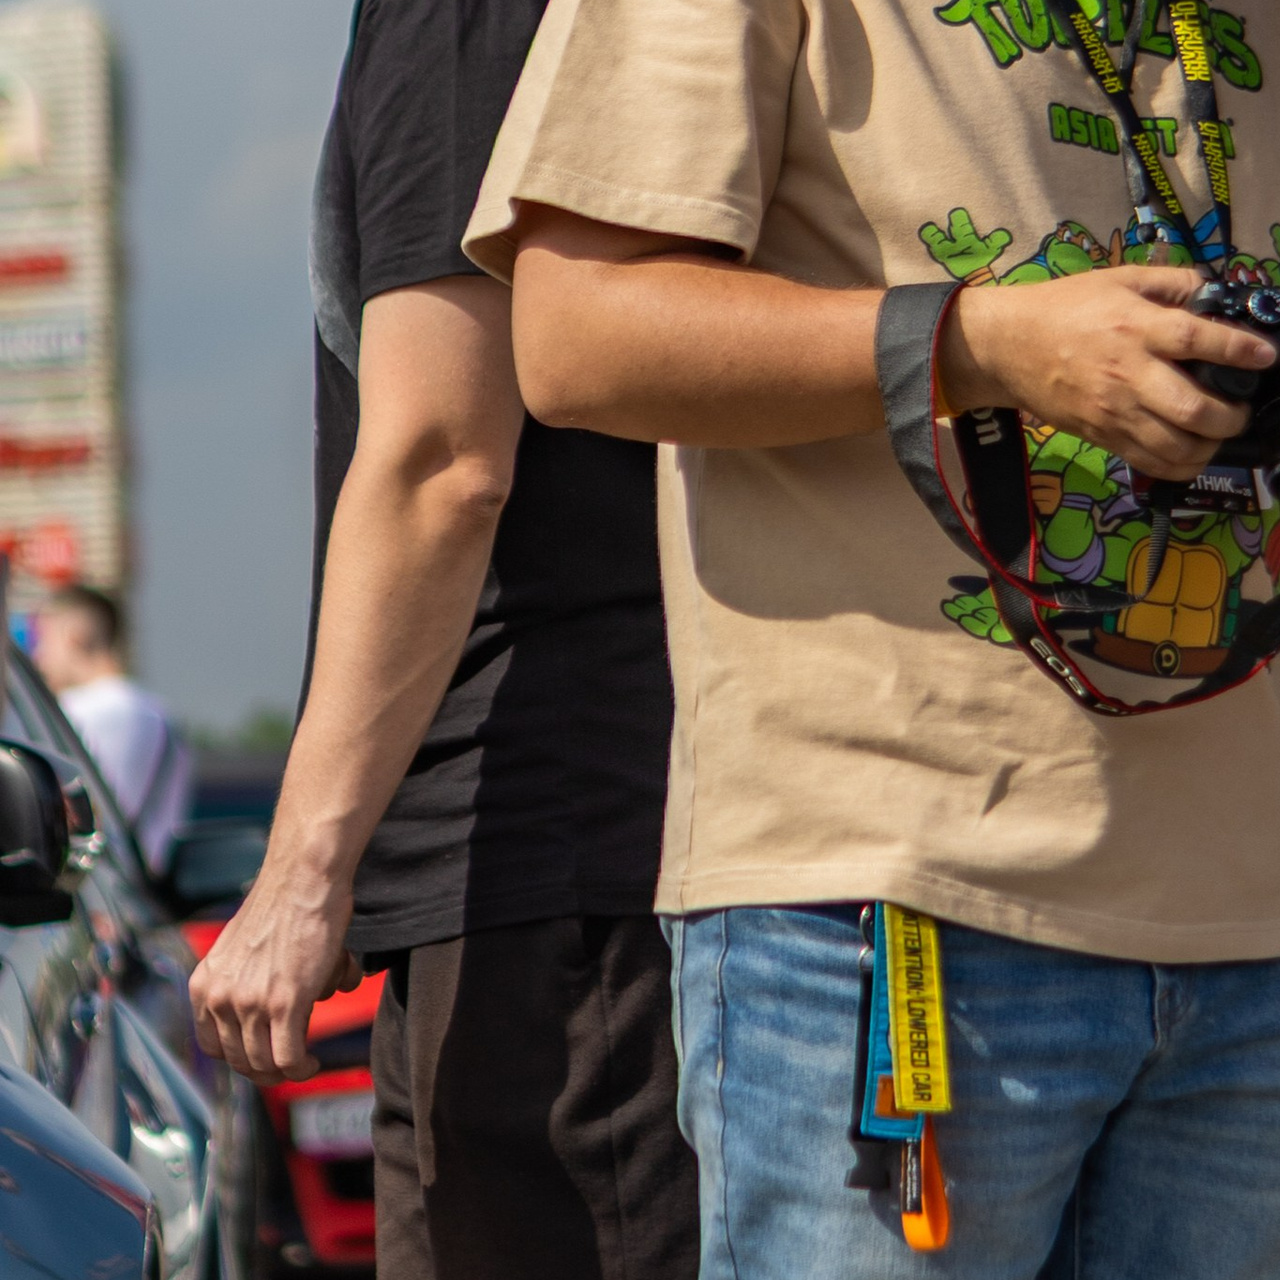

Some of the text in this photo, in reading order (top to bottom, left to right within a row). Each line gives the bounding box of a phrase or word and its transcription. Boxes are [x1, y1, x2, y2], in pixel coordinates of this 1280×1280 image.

[1048, 102, 1120, 156] ASIA
[1190, 474, 1236, 494] ТНИК
[1028, 635, 1088, 698] EOS
[900, 911, 932, 1103] ATTENTION: LOWERED CAR
